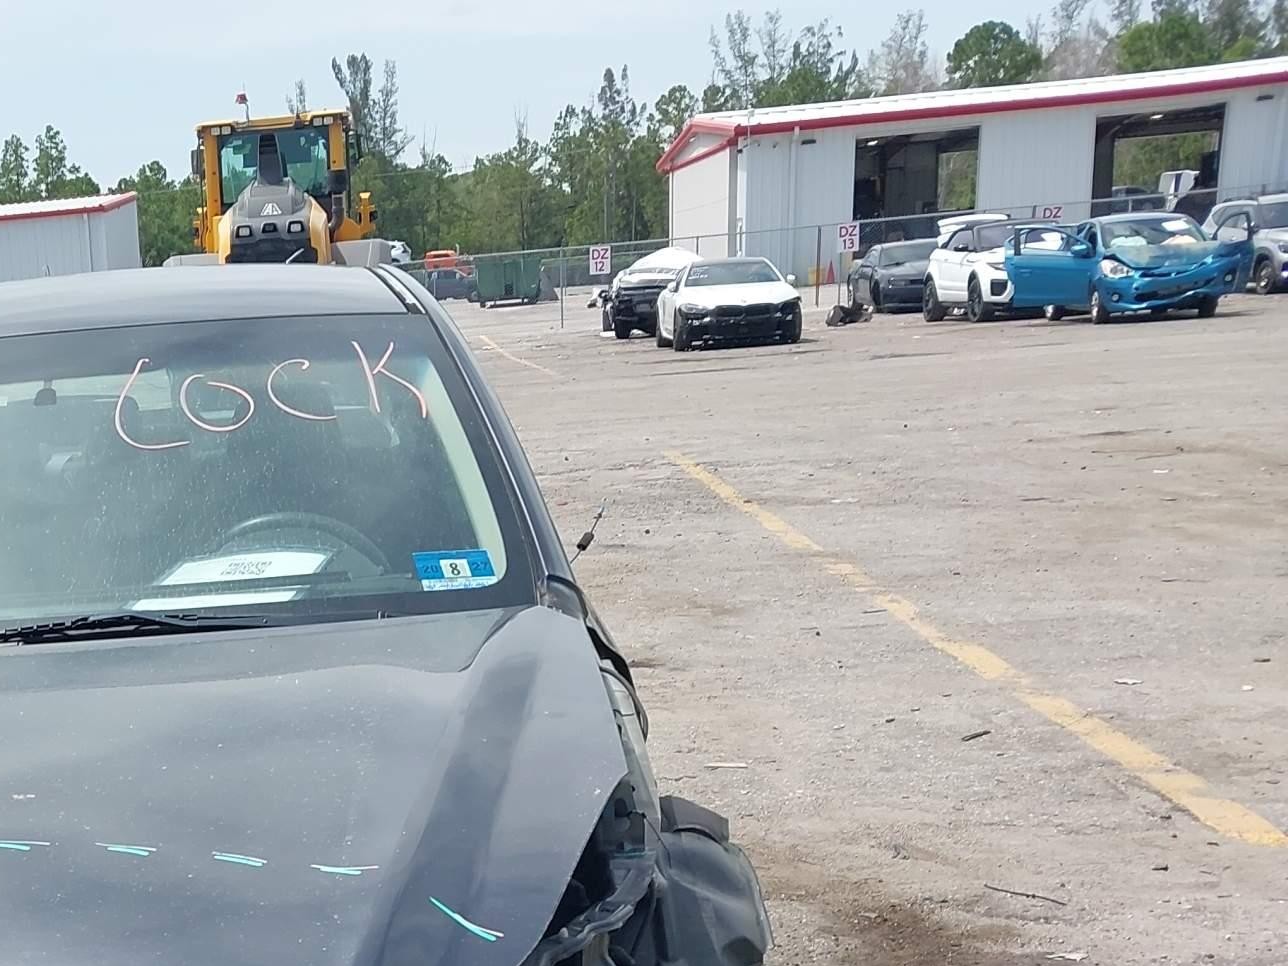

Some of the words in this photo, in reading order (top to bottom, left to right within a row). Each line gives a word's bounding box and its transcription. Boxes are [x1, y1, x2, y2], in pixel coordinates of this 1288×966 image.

[1042, 206, 1062, 219] DZ
[839, 224, 857, 238] DZ
[842, 238, 855, 250] 13
[591, 247, 609, 260] DZ
[594, 260, 605, 272] 12
[114, 340, 427, 450] LOCK
[449, 562, 461, 576] 8
